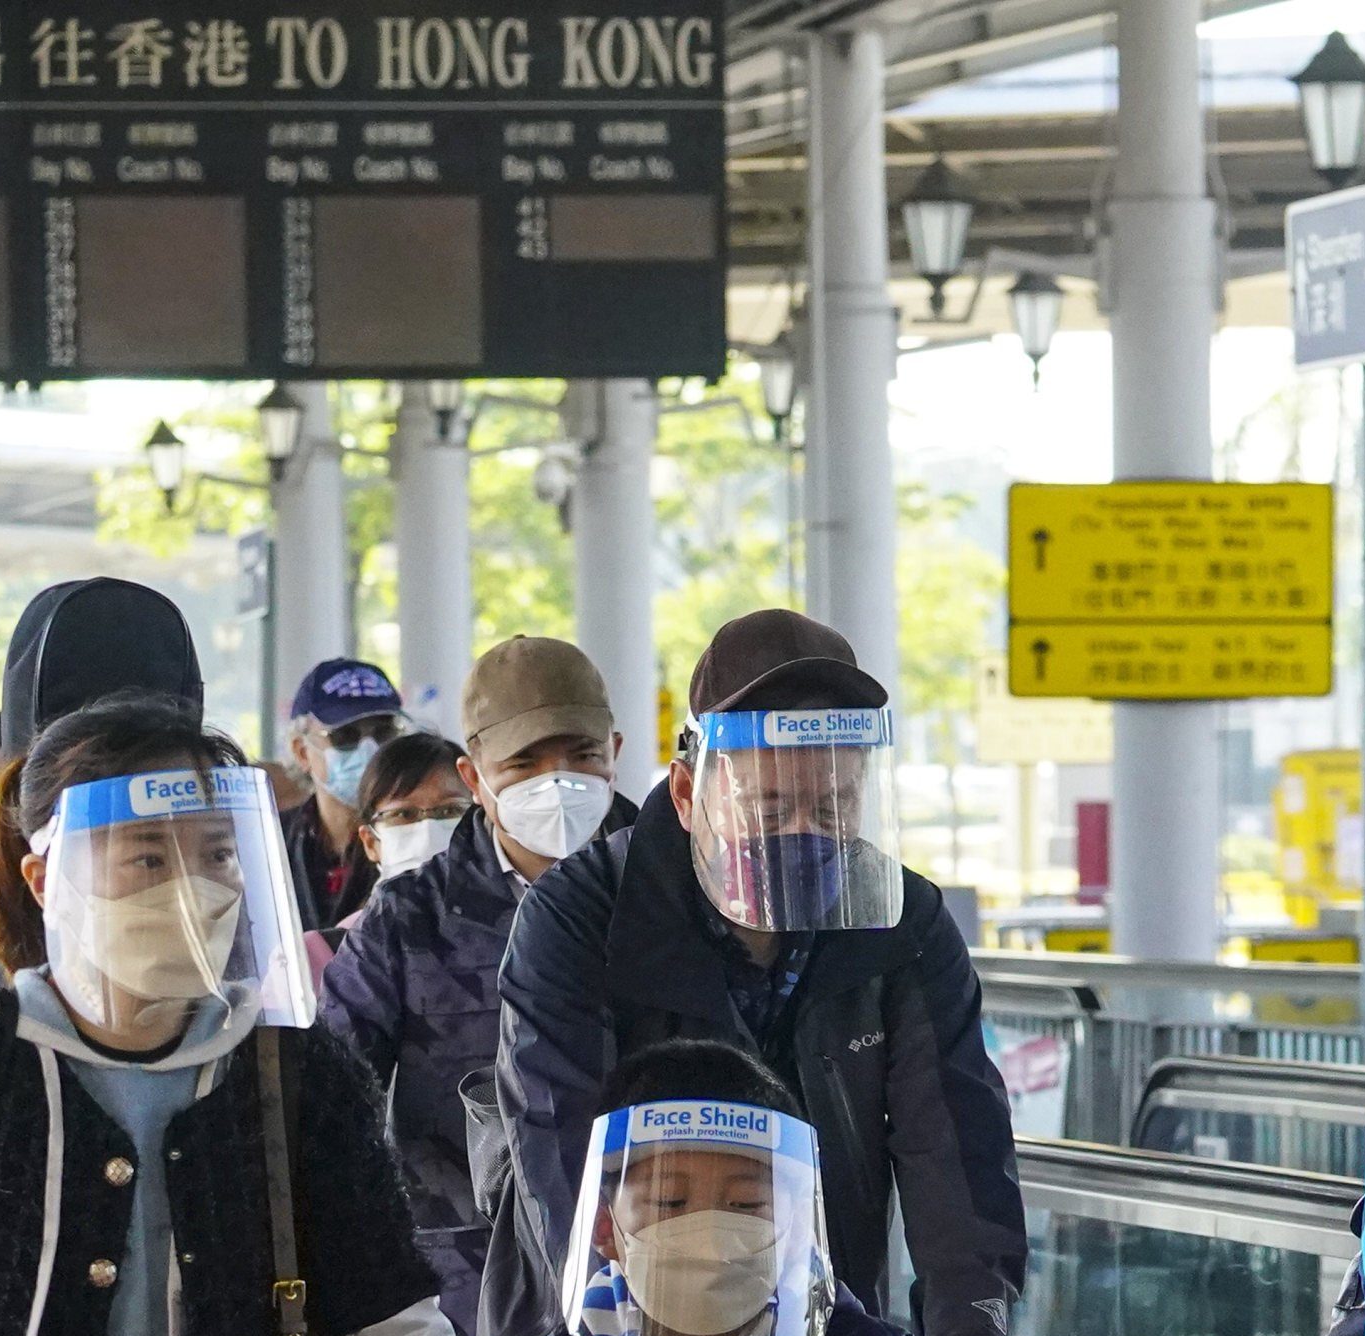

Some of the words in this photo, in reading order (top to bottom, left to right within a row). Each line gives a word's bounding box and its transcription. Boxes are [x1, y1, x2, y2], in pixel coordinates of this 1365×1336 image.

[32, 18, 250, 89] 往香港
[266, 18, 349, 89] TO
[376, 18, 531, 90] HONG
[560, 18, 715, 90] KONG
[777, 715, 821, 732] Face
[826, 711, 873, 731] Shield
[796, 733, 823, 743] splash
[145, 780, 196, 799] Face
[643, 1109, 691, 1127] Face
[699, 1106, 768, 1133] Shield
[663, 1127, 694, 1138] splash
[697, 1127, 749, 1140] protection
